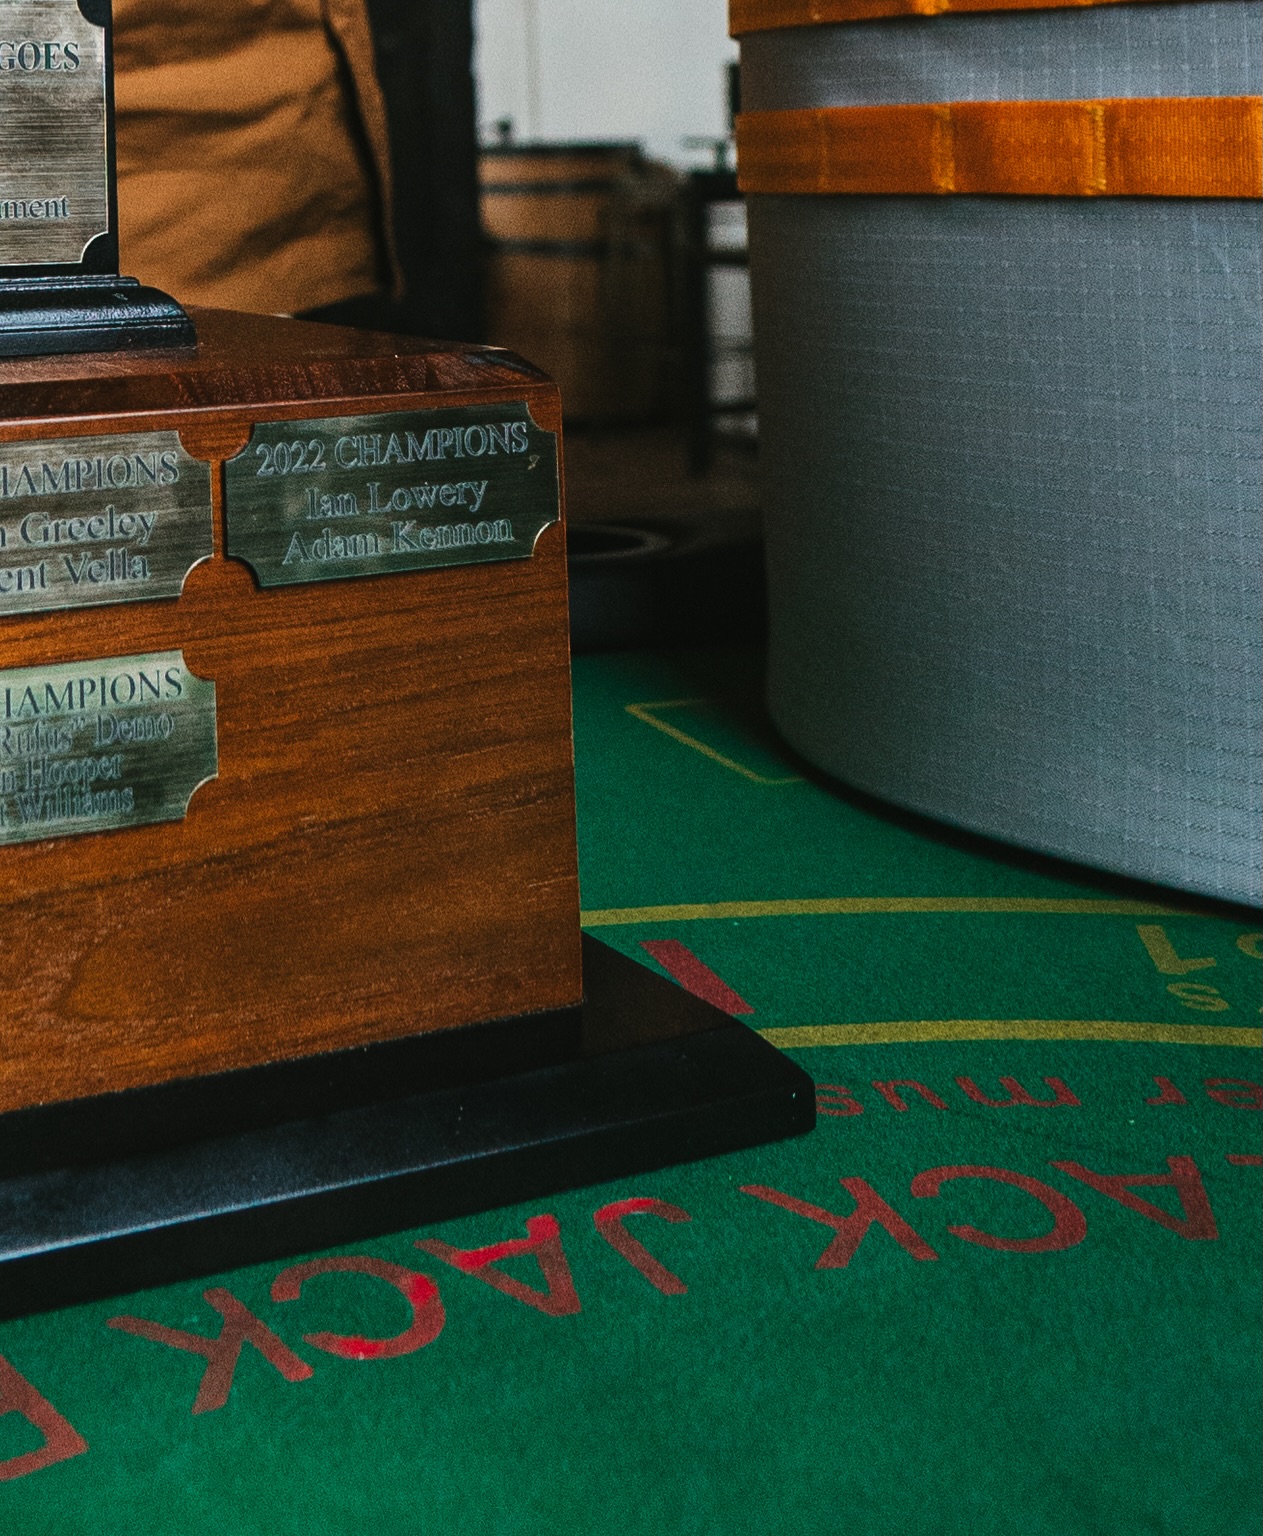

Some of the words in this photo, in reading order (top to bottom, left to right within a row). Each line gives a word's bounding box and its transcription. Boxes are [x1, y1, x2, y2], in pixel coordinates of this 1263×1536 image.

[255, 438, 327, 477] 2022
[334, 420, 529, 469] CHAMPIONS
[305, 485, 360, 520] Ian
[367, 479, 488, 514] Lowery
[20, 505, 158, 546] Greeley
[281, 527, 381, 565] Adam
[391, 517, 515, 555] Kennon
[63, 547, 152, 585] Vella
[15, 783, 135, 825] Williams
[739, 1154, 1263, 1269] ACK
[106, 1197, 693, 1416] JACK
